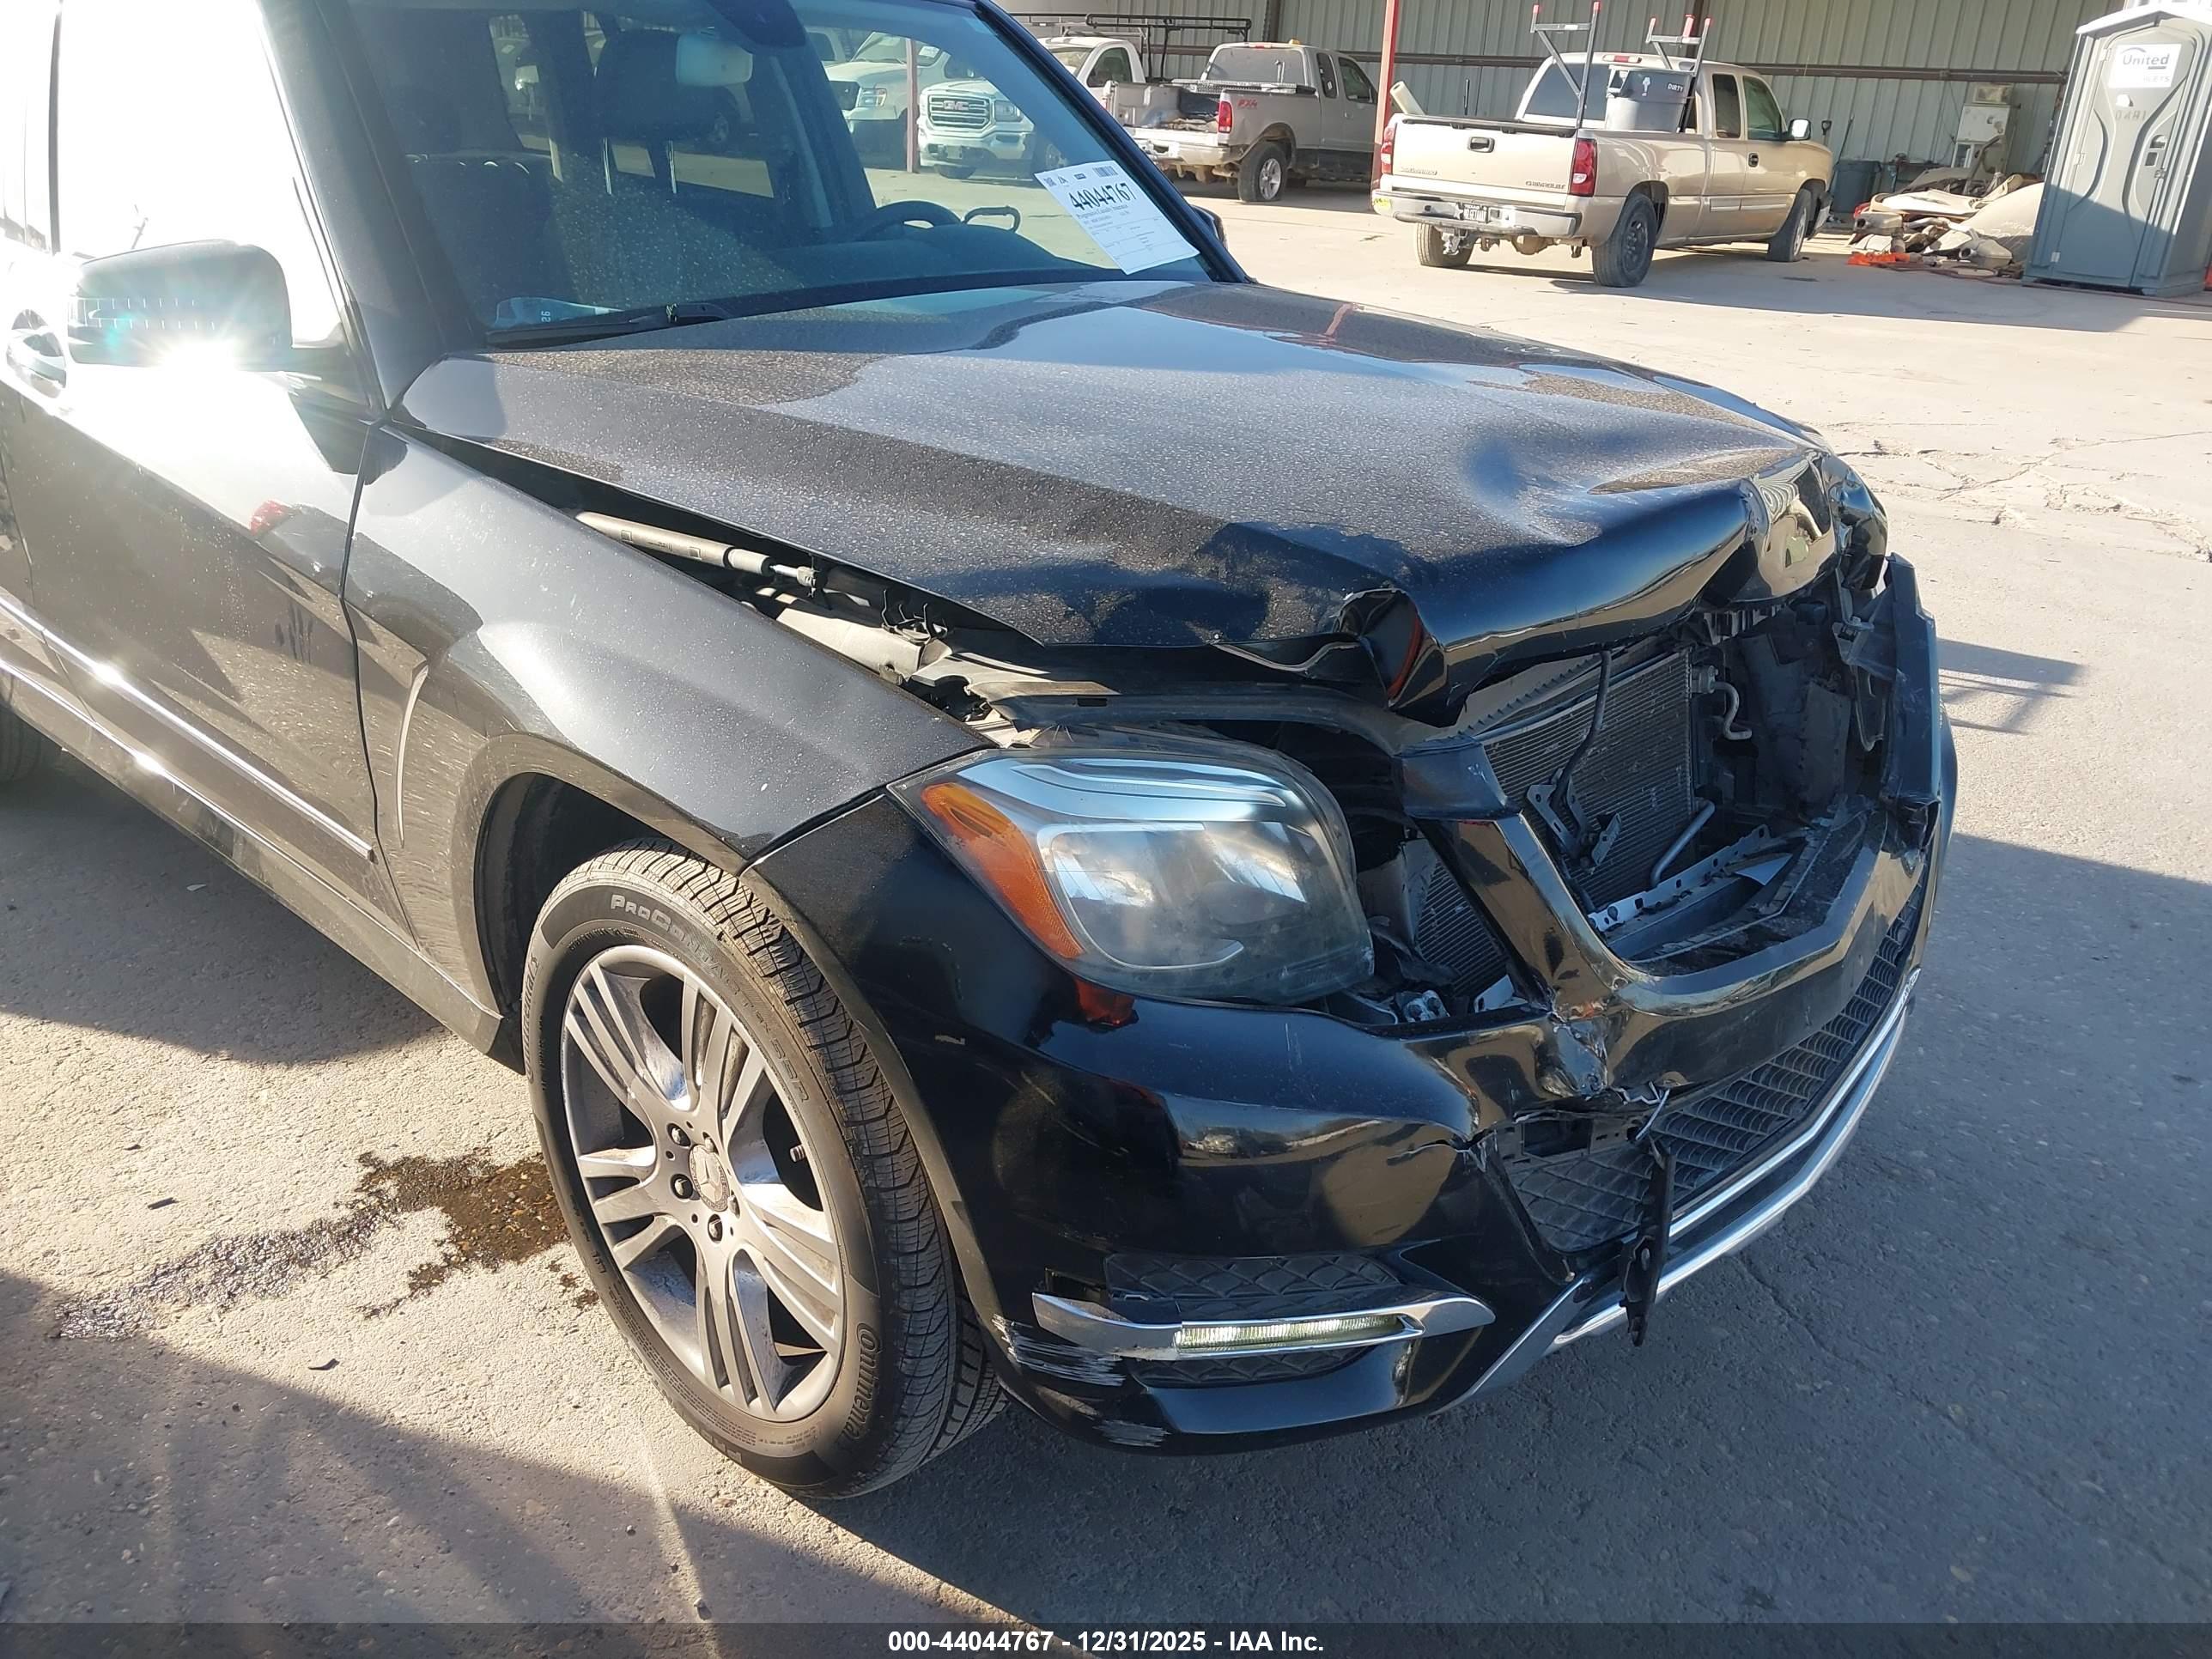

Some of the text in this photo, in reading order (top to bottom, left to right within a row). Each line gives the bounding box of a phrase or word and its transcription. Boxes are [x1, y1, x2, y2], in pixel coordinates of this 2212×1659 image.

[2123, 53, 2170, 65] United
[1667, 82, 1684, 92] DIRTY
[943, 100, 969, 111] GMC
[1068, 182, 1137, 210] 44044767
